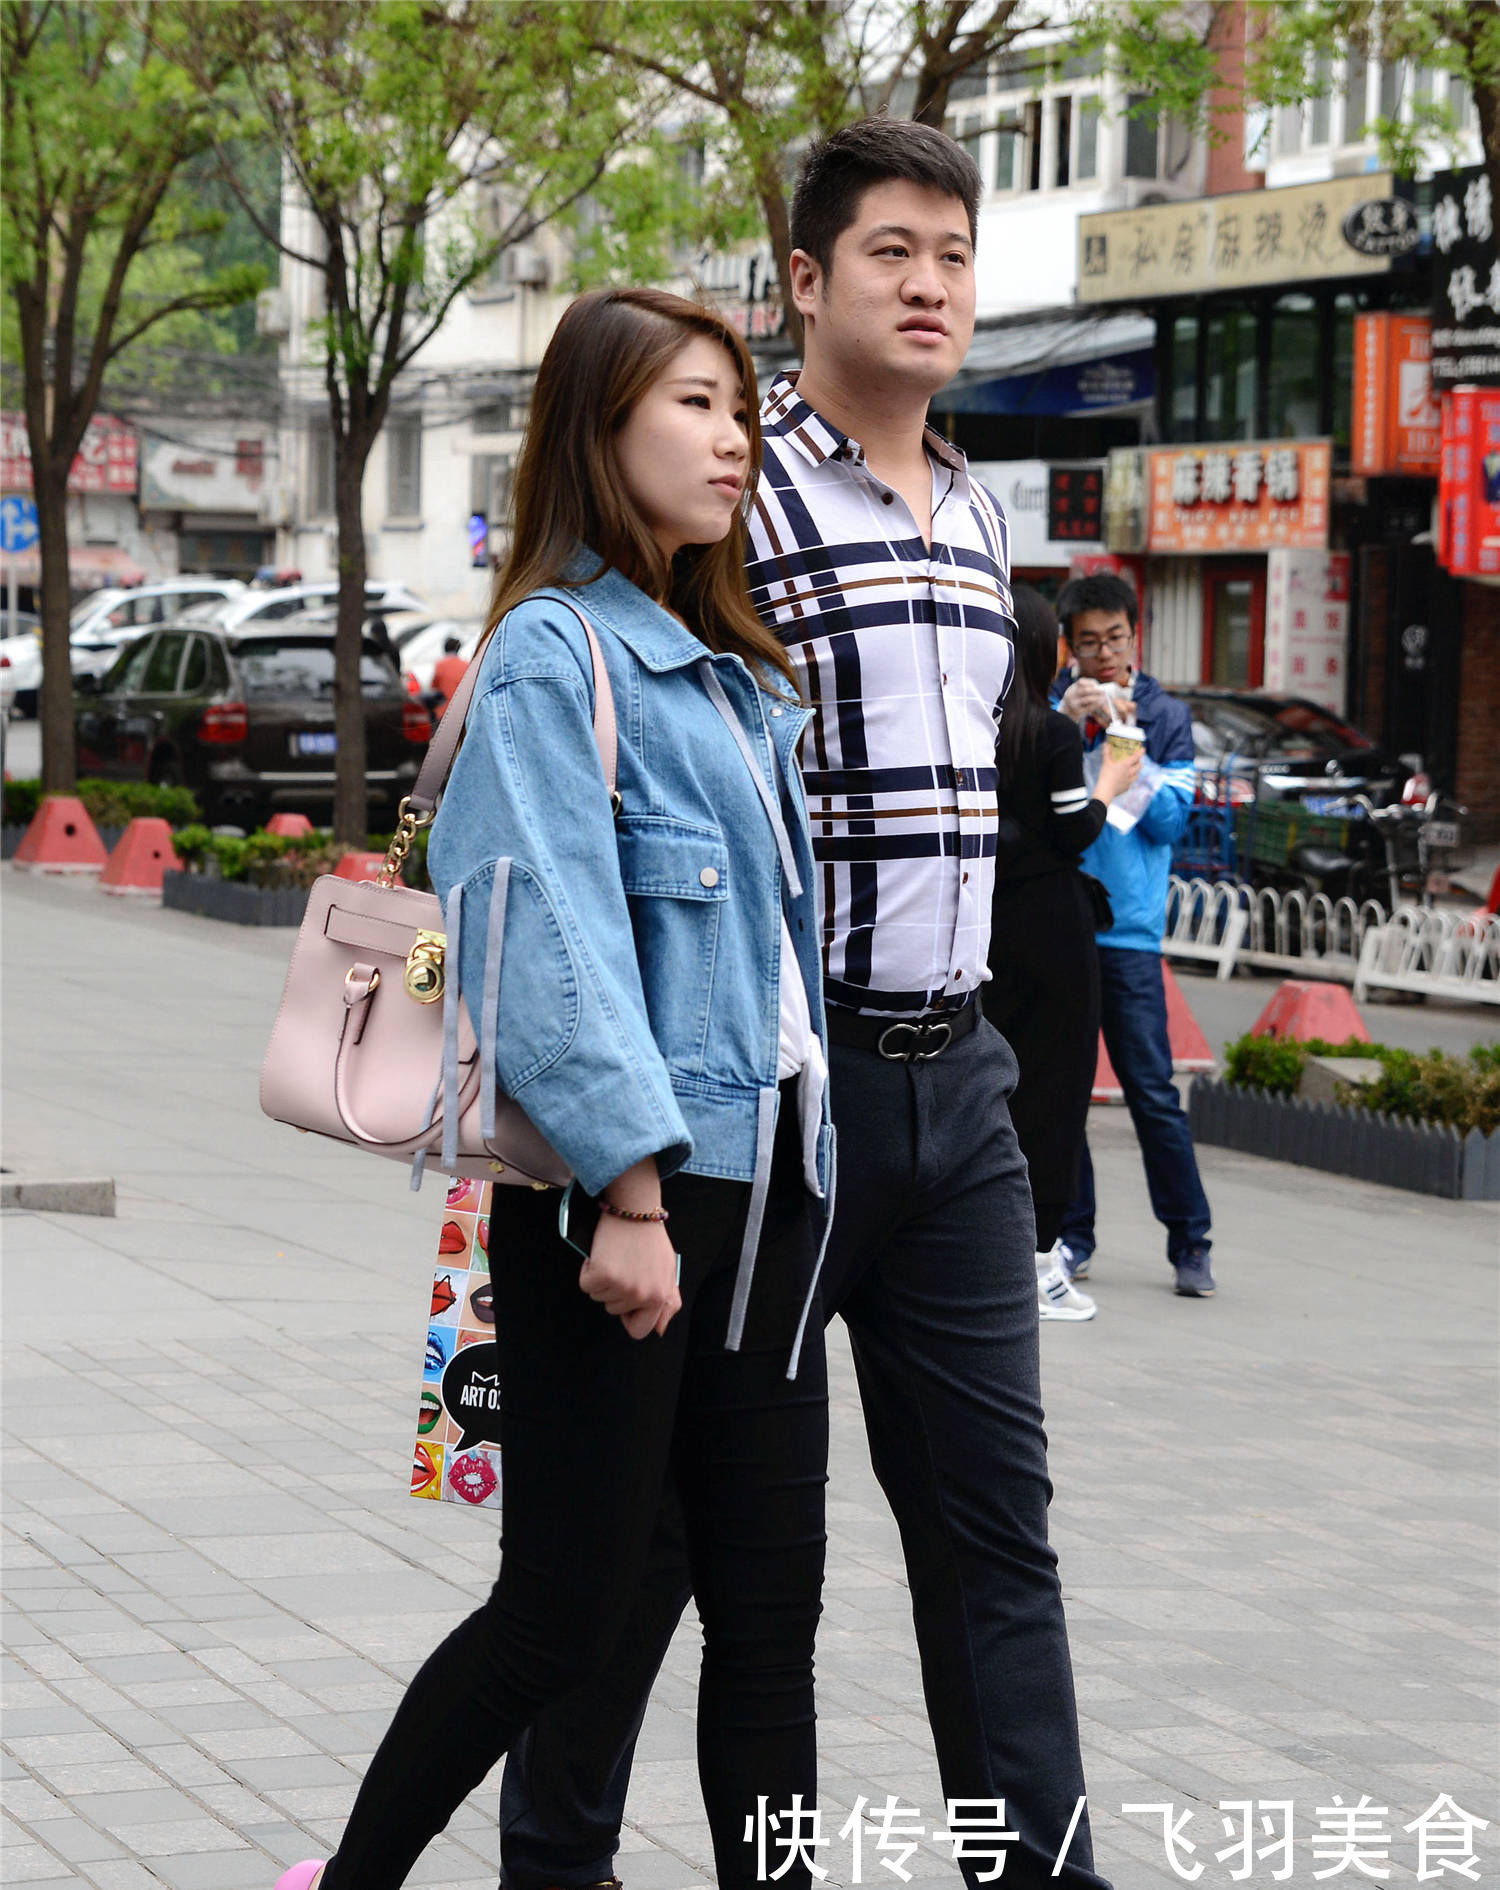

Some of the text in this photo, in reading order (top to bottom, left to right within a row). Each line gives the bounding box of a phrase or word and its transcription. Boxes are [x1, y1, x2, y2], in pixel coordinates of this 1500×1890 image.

[1174, 450, 1298, 503] 麻辣香锅
[460, 1384, 486, 1407] ART
